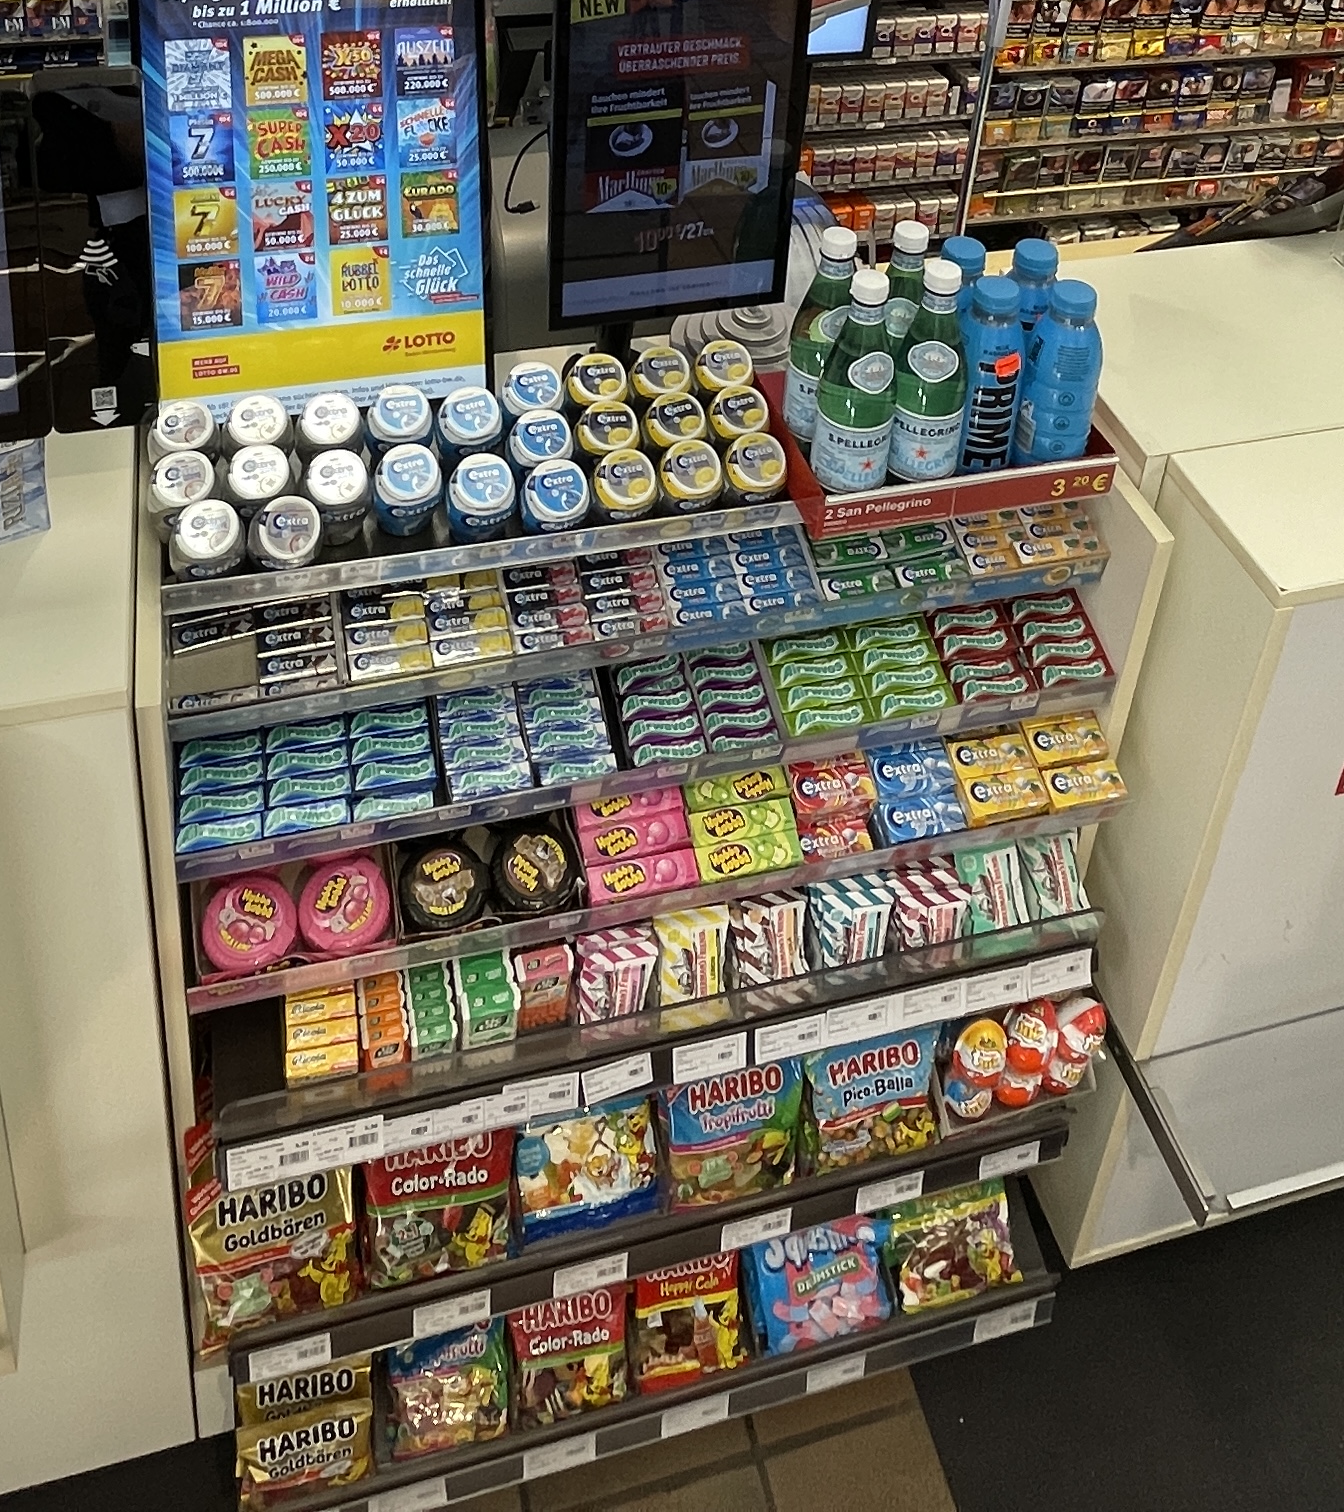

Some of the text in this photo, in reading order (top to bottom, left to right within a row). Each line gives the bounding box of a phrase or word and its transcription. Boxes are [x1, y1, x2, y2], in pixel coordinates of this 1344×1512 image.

[192, 4, 215, 19] bis
[217, 6, 235, 17] zu
[240, 0, 248, 16] 1
[617, 37, 744, 58] VERTRAUTER GESCHMACK.
[253, 50, 297, 67] MEGA
[618, 54, 709, 73] ÜBERRASCHENDER
[252, 69, 298, 84] CASH
[404, 79, 437, 90] 220.000
[255, 90, 290, 100] 500.000
[329, 84, 364, 96] 500.000
[257, 122, 302, 137] SUPER
[255, 139, 305, 159] CASH
[408, 152, 437, 162] 25.000
[258, 163, 292, 174] 250.000
[255, 195, 306, 209] LUCKY
[332, 190, 382, 204] 4 ZUM
[332, 206, 384, 221] GLÜCK
[265, 235, 295, 245] 50.000
[340, 227, 368, 238] 25.000
[341, 263, 378, 278] RUBBEL
[418, 255, 438, 269] Das
[265, 272, 298, 287] WILD
[405, 265, 452, 278] schnelle
[415, 277, 458, 294] Glück
[270, 288, 305, 302] CASH
[193, 314, 221, 324] 15.000
[405, 332, 455, 349] LOTTO
[837, 497, 932, 518] San Pellegrino
[351, 604, 386, 619] extra
[855, 624, 926, 647] Airwaves
[942, 630, 1010, 654] Airwaves
[773, 634, 842, 659] Airwaves
[1042, 660, 1107, 684] Airwaves
[1035, 730, 1074, 748] extra
[882, 761, 927, 782] extra
[801, 779, 842, 795] extra
[1054, 772, 1093, 790] extra
[828, 1039, 921, 1086] HARIBO
[688, 1065, 783, 1113] HARIBO
[842, 1074, 914, 1107] Pico-Balla
[700, 1097, 775, 1133] Tropifrutti
[392, 1167, 489, 1197] Color-Rado
[217, 1173, 328, 1227] HARIBO
[224, 1210, 327, 1252] Goldbären
[522, 1288, 612, 1332] HARIBO
[528, 1327, 610, 1356] Color-Rado
[257, 1368, 354, 1408] HARIBO
[258, 1417, 356, 1464] HARIBO
[268, 1445, 353, 1480] Goldbären
